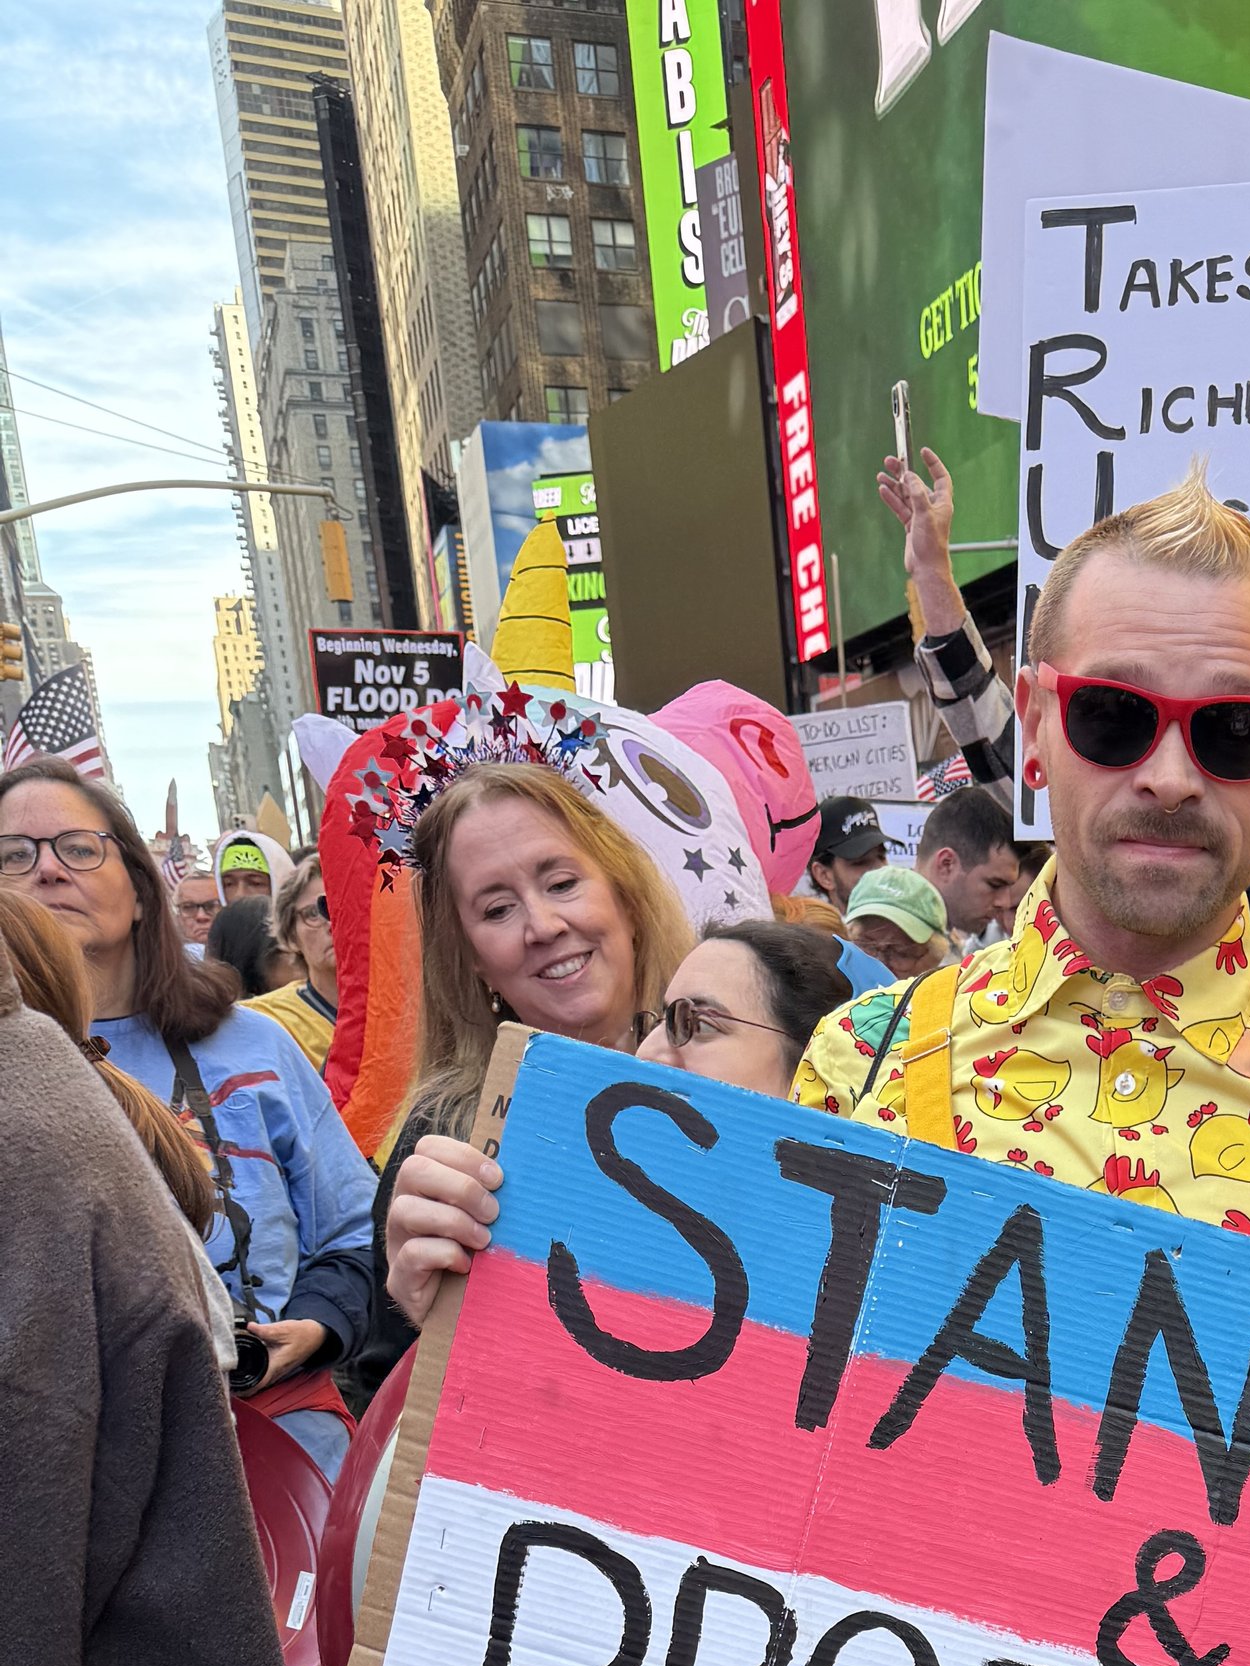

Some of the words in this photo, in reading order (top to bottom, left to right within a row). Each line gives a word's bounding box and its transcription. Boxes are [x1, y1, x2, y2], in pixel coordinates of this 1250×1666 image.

[919, 285, 954, 359] GET
[783, 370, 816, 530] FREE
[316, 637, 381, 656] Beginning
[354, 659, 406, 684] Nov
[412, 660, 430, 685] 5
[327, 686, 419, 713] FLOOD
[866, 744, 907, 765] CITIES
